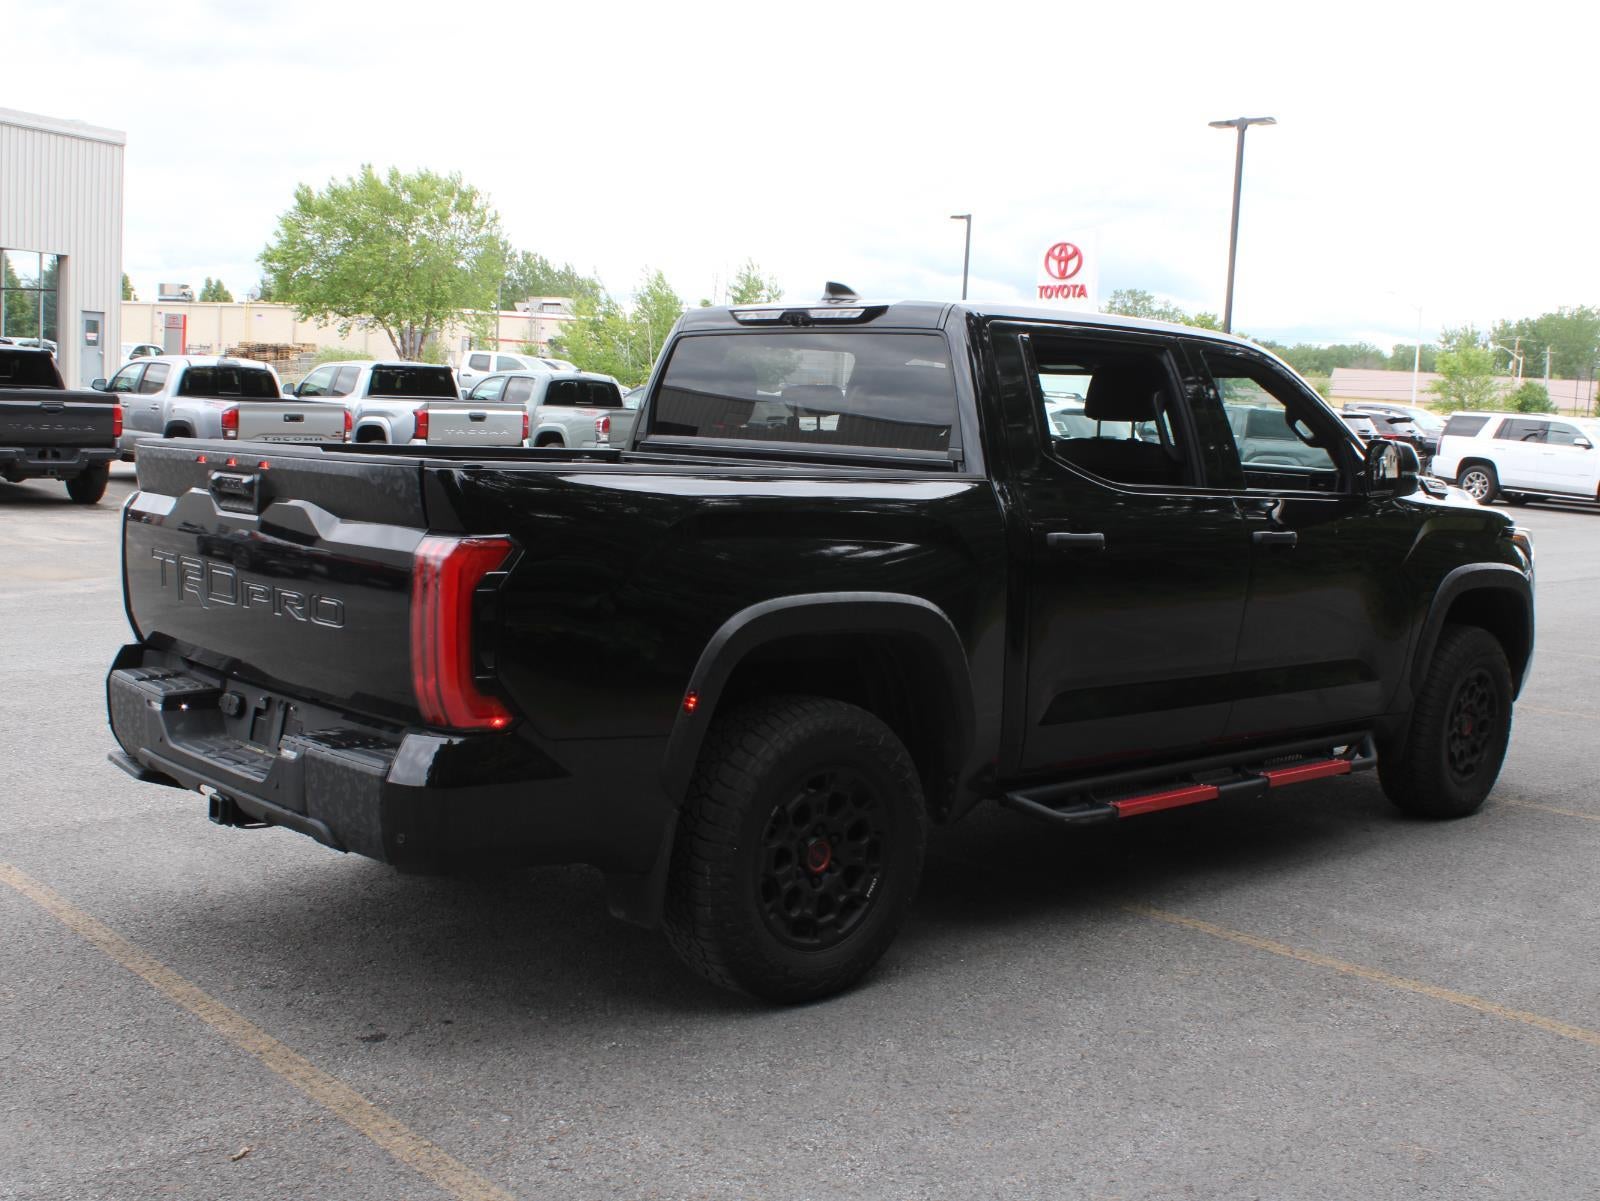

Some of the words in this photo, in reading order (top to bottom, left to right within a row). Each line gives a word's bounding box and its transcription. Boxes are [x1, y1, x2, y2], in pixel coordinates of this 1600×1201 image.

[1038, 284, 1088, 299] TOYOTA
[8, 423, 97, 432] TACOMA
[444, 428, 511, 437] TACOMA
[151, 548, 239, 610] TRD
[241, 580, 346, 629] PRO
